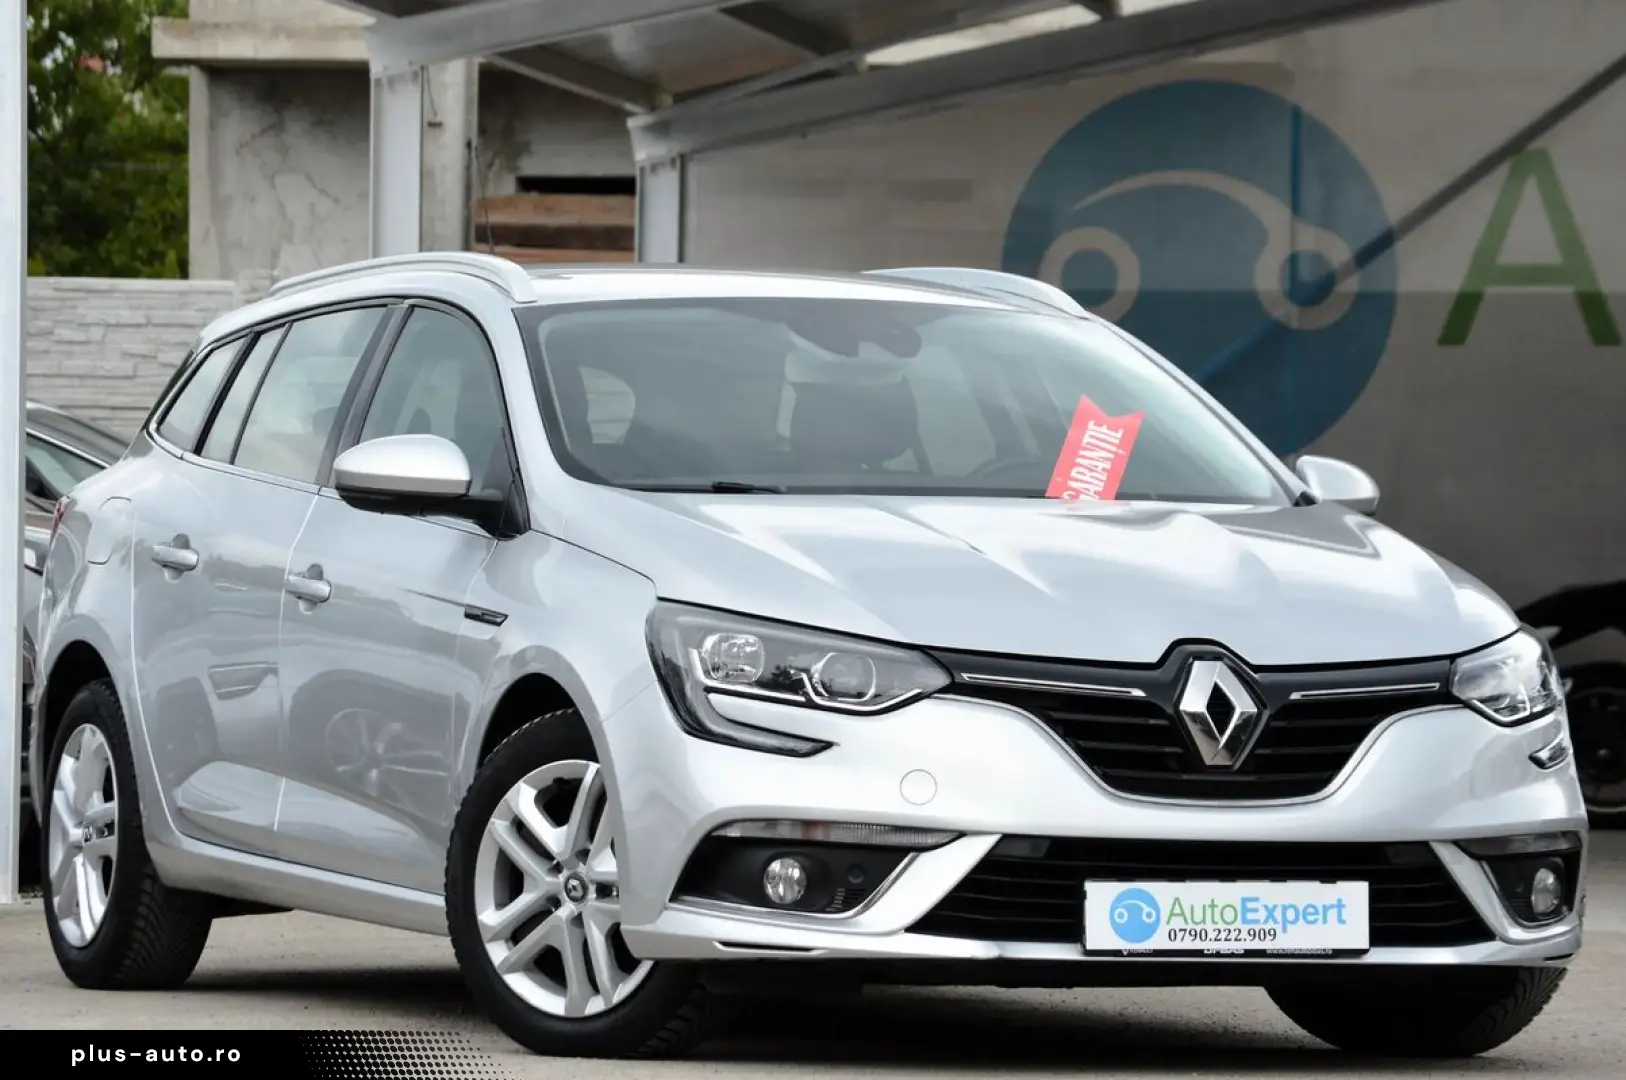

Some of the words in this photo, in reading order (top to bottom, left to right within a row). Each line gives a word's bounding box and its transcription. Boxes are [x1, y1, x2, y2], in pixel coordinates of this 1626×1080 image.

[1436, 147, 1622, 347] A
[1166, 896, 1346, 933] AutoExpert
[1168, 928, 1277, 942] 0790.222.909
